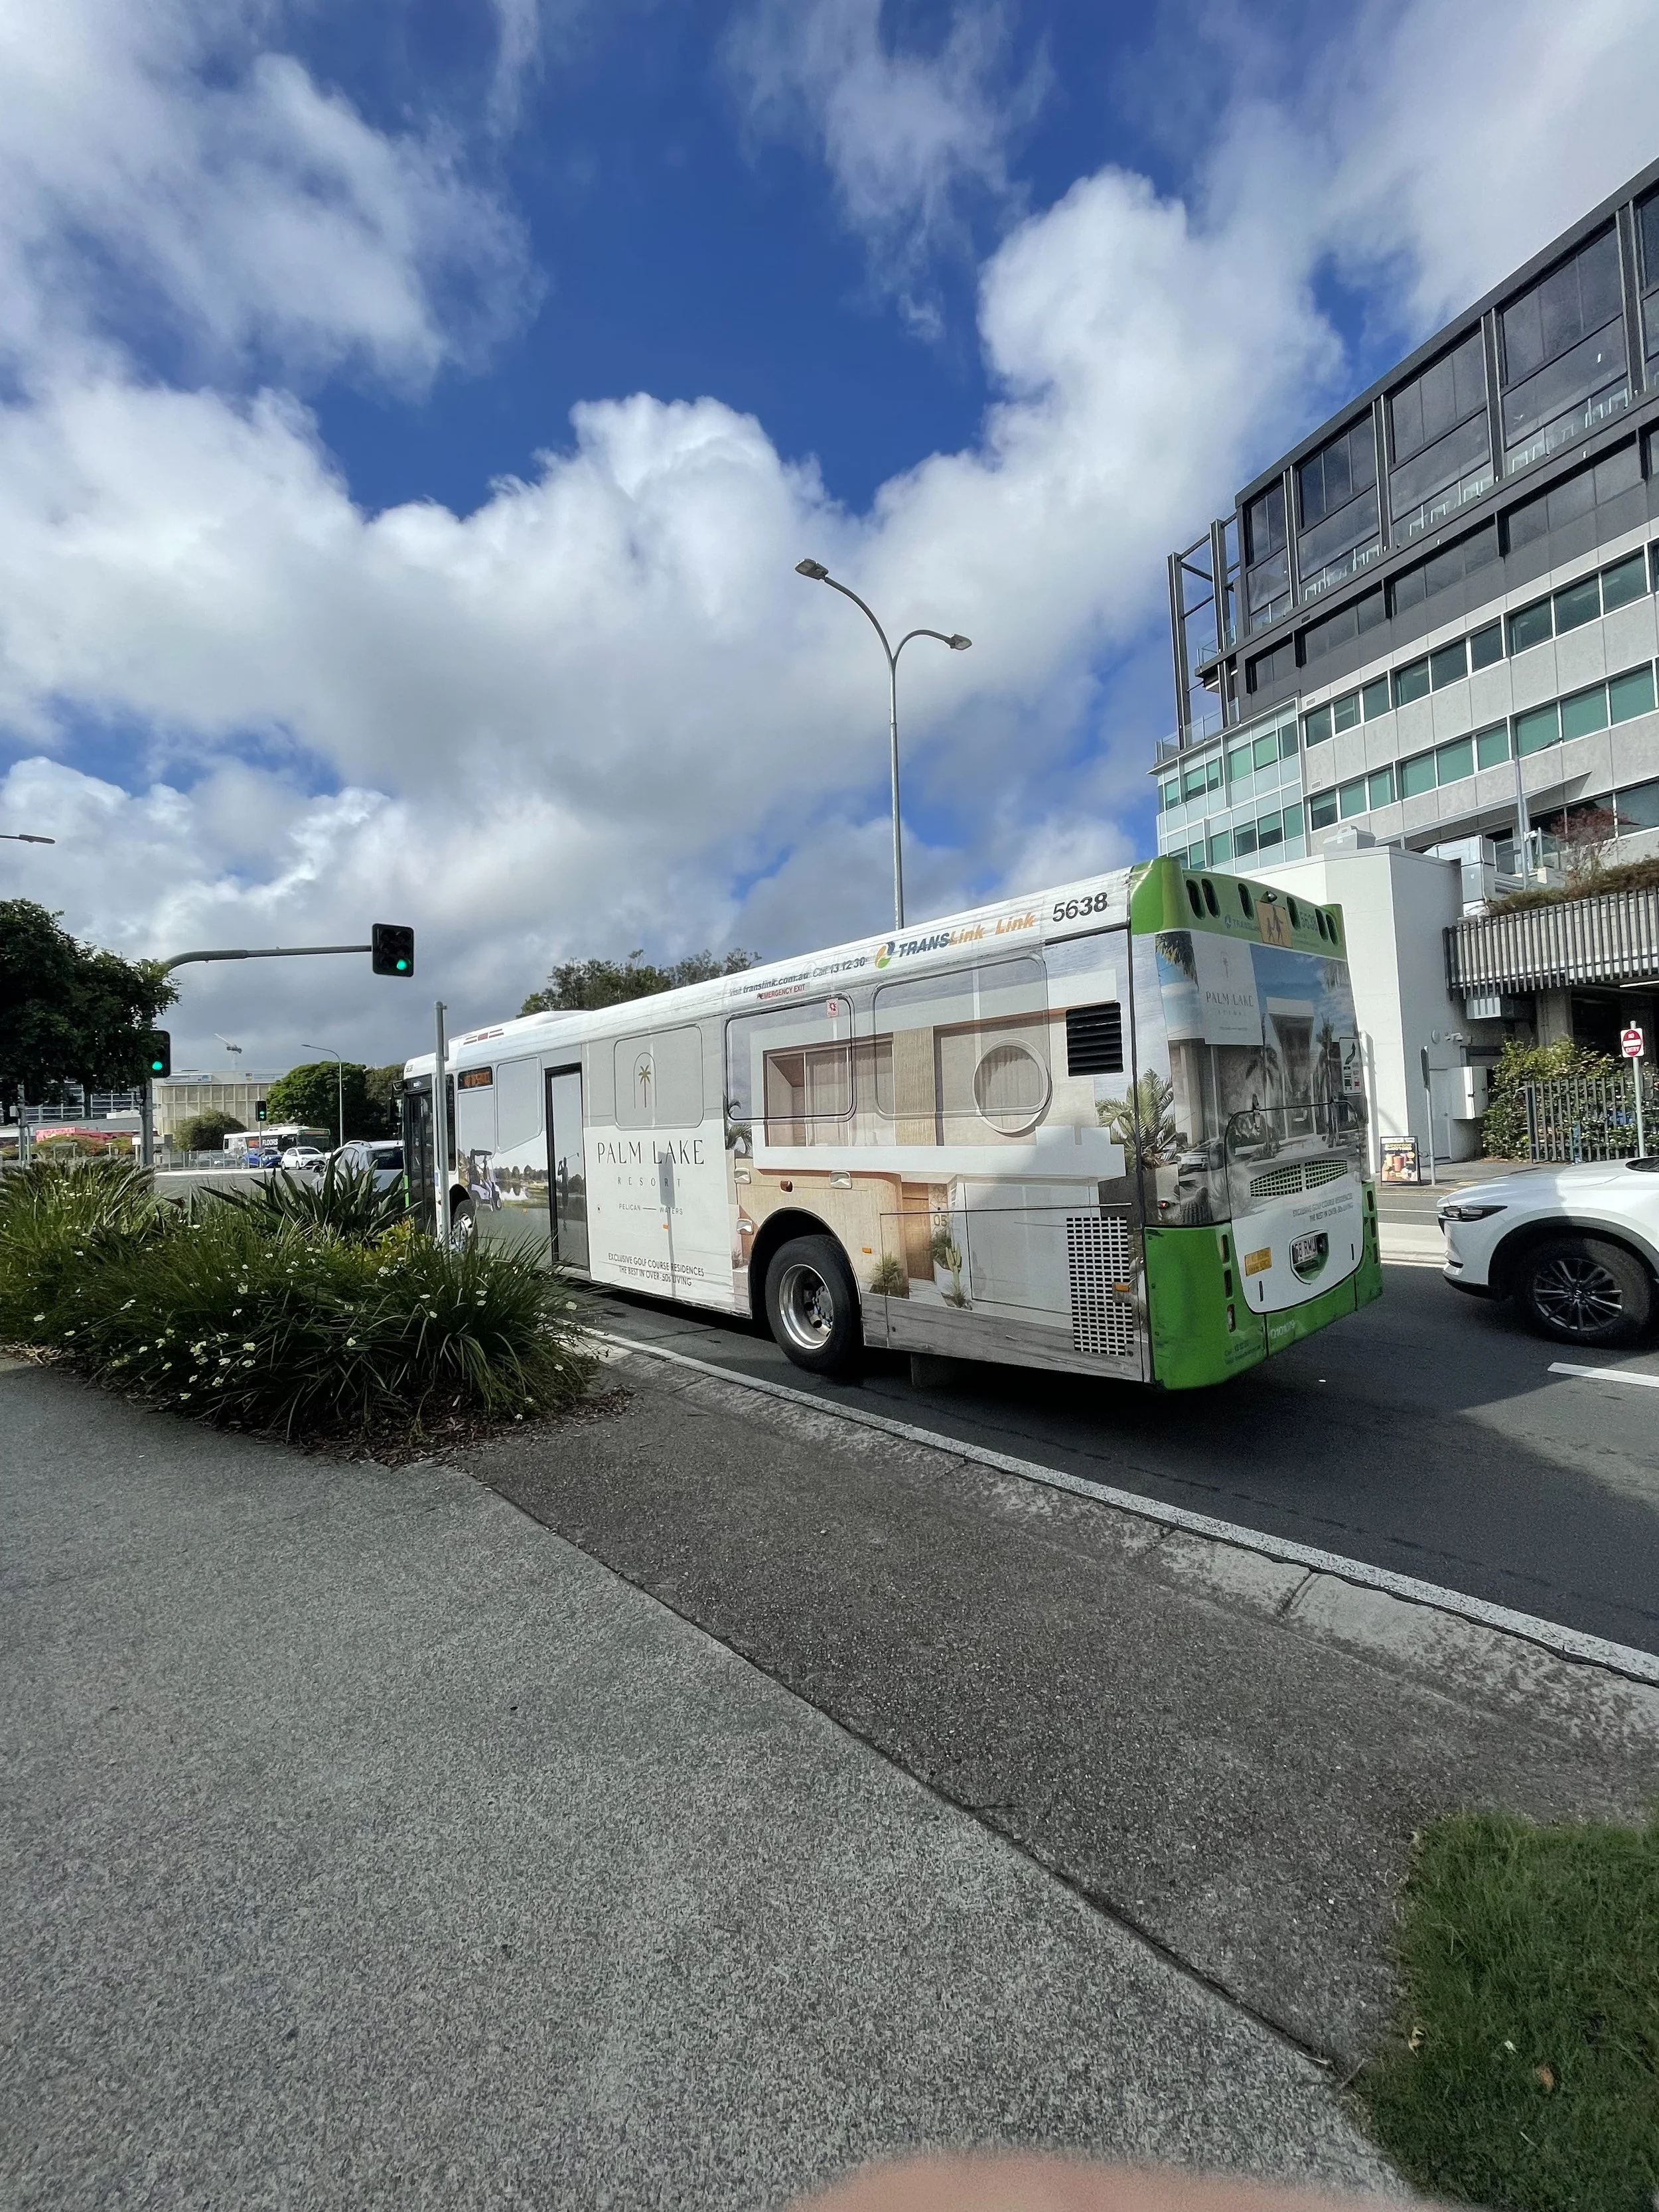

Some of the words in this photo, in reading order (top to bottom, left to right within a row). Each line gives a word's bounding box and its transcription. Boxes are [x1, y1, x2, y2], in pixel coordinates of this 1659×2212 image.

[1052, 892, 1108, 922] 5638
[899, 924, 984, 958] TRANSLink
[995, 912, 1035, 935] Link
[743, 972, 809, 994] translink.com.au
[853, 956, 865, 968] 30
[760, 986, 792, 999] EMERGENCY
[794, 984, 806, 993] EXIT
[1206, 991, 1230, 1005] PALM
[597, 1141, 642, 1163] PALM
[652, 1140, 705, 1165] LAKE
[617, 1176, 681, 1187] RESORT
[659, 1207, 683, 1215] WATERS
[934, 1215, 947, 1227] 05
[608, 1252, 632, 1264] EXCLUSIVE
[633, 1257, 647, 1267] GOLF
[648, 1260, 670, 1271] COURSE
[670, 1263, 705, 1277] RESIDENCES
[628, 1267, 638, 1276] BEST
[646, 1270, 672, 1283] OVER-50s
[672, 1274, 692, 1286] LIVING
